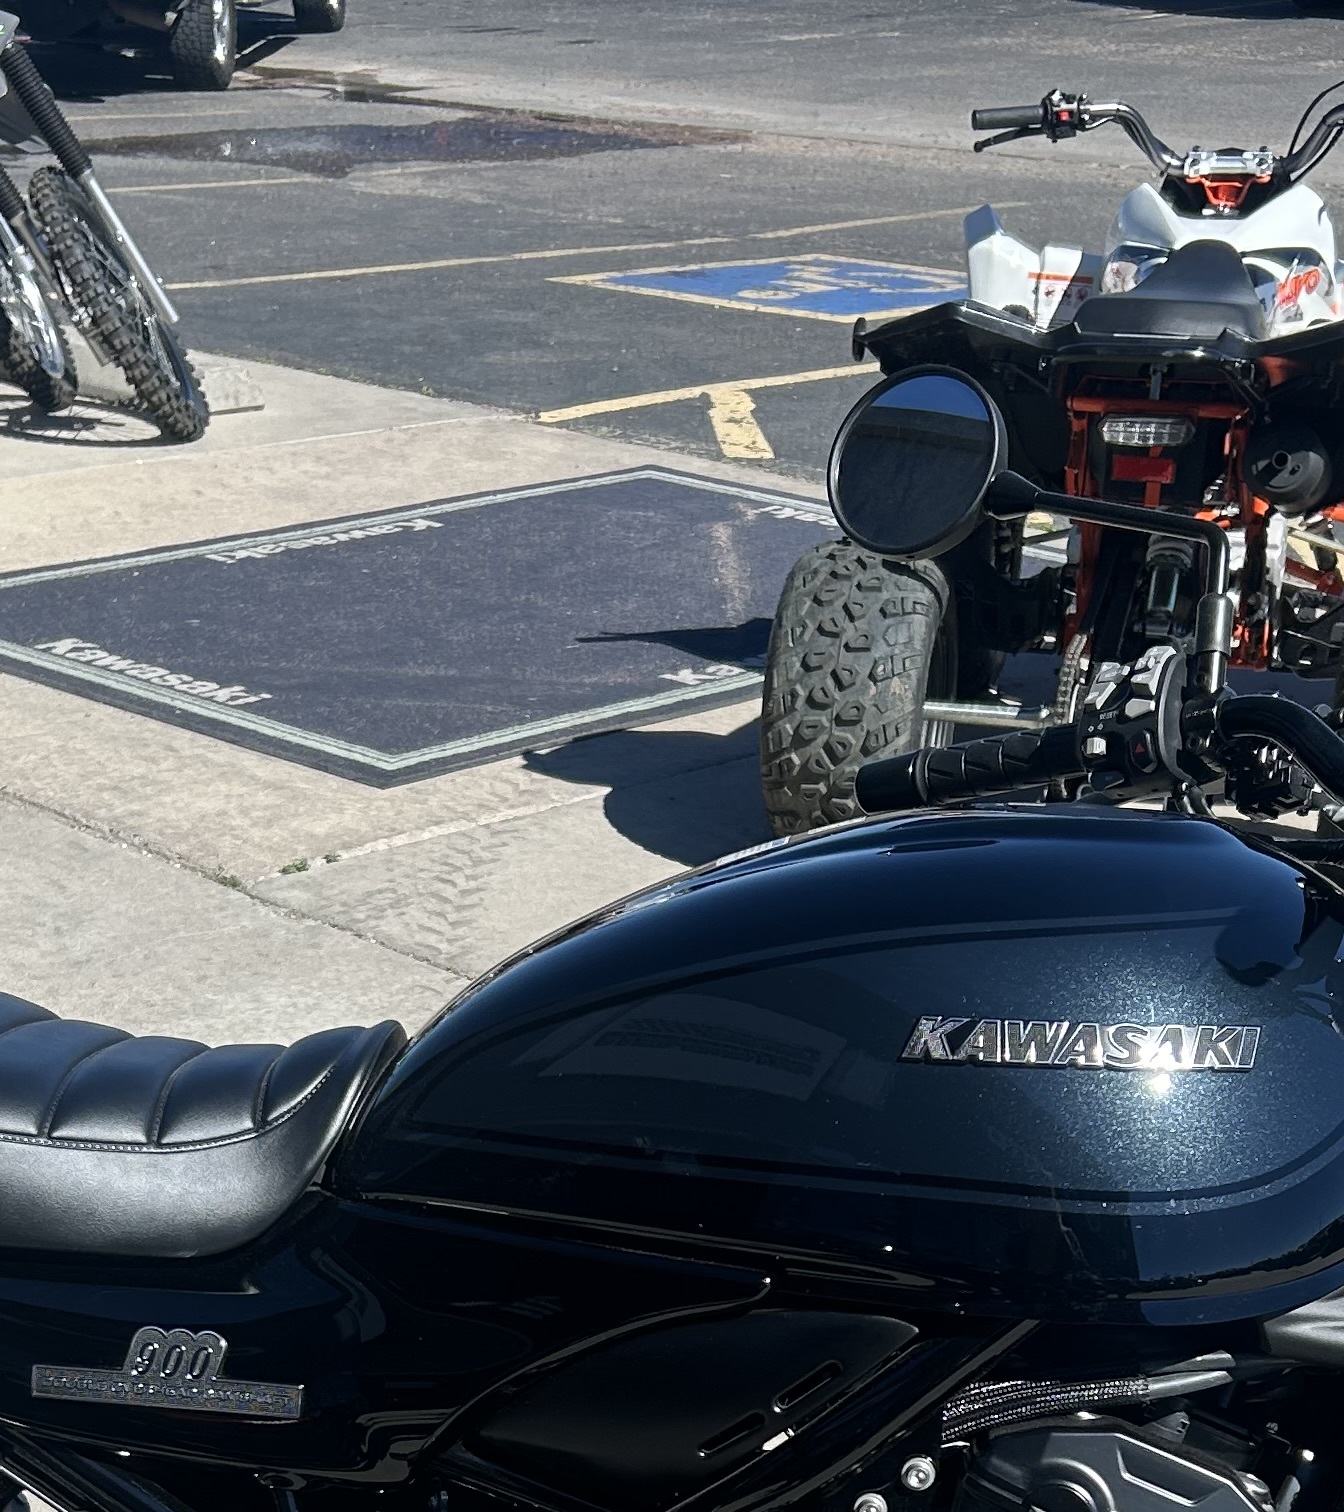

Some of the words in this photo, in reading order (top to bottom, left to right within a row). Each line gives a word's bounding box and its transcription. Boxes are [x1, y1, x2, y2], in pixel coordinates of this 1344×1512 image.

[205, 518, 444, 564] Kawasaki
[35, 637, 273, 706] Kawasaki
[898, 1014, 1263, 1070] KAWASAKI
[131, 1342, 214, 1380] 900
